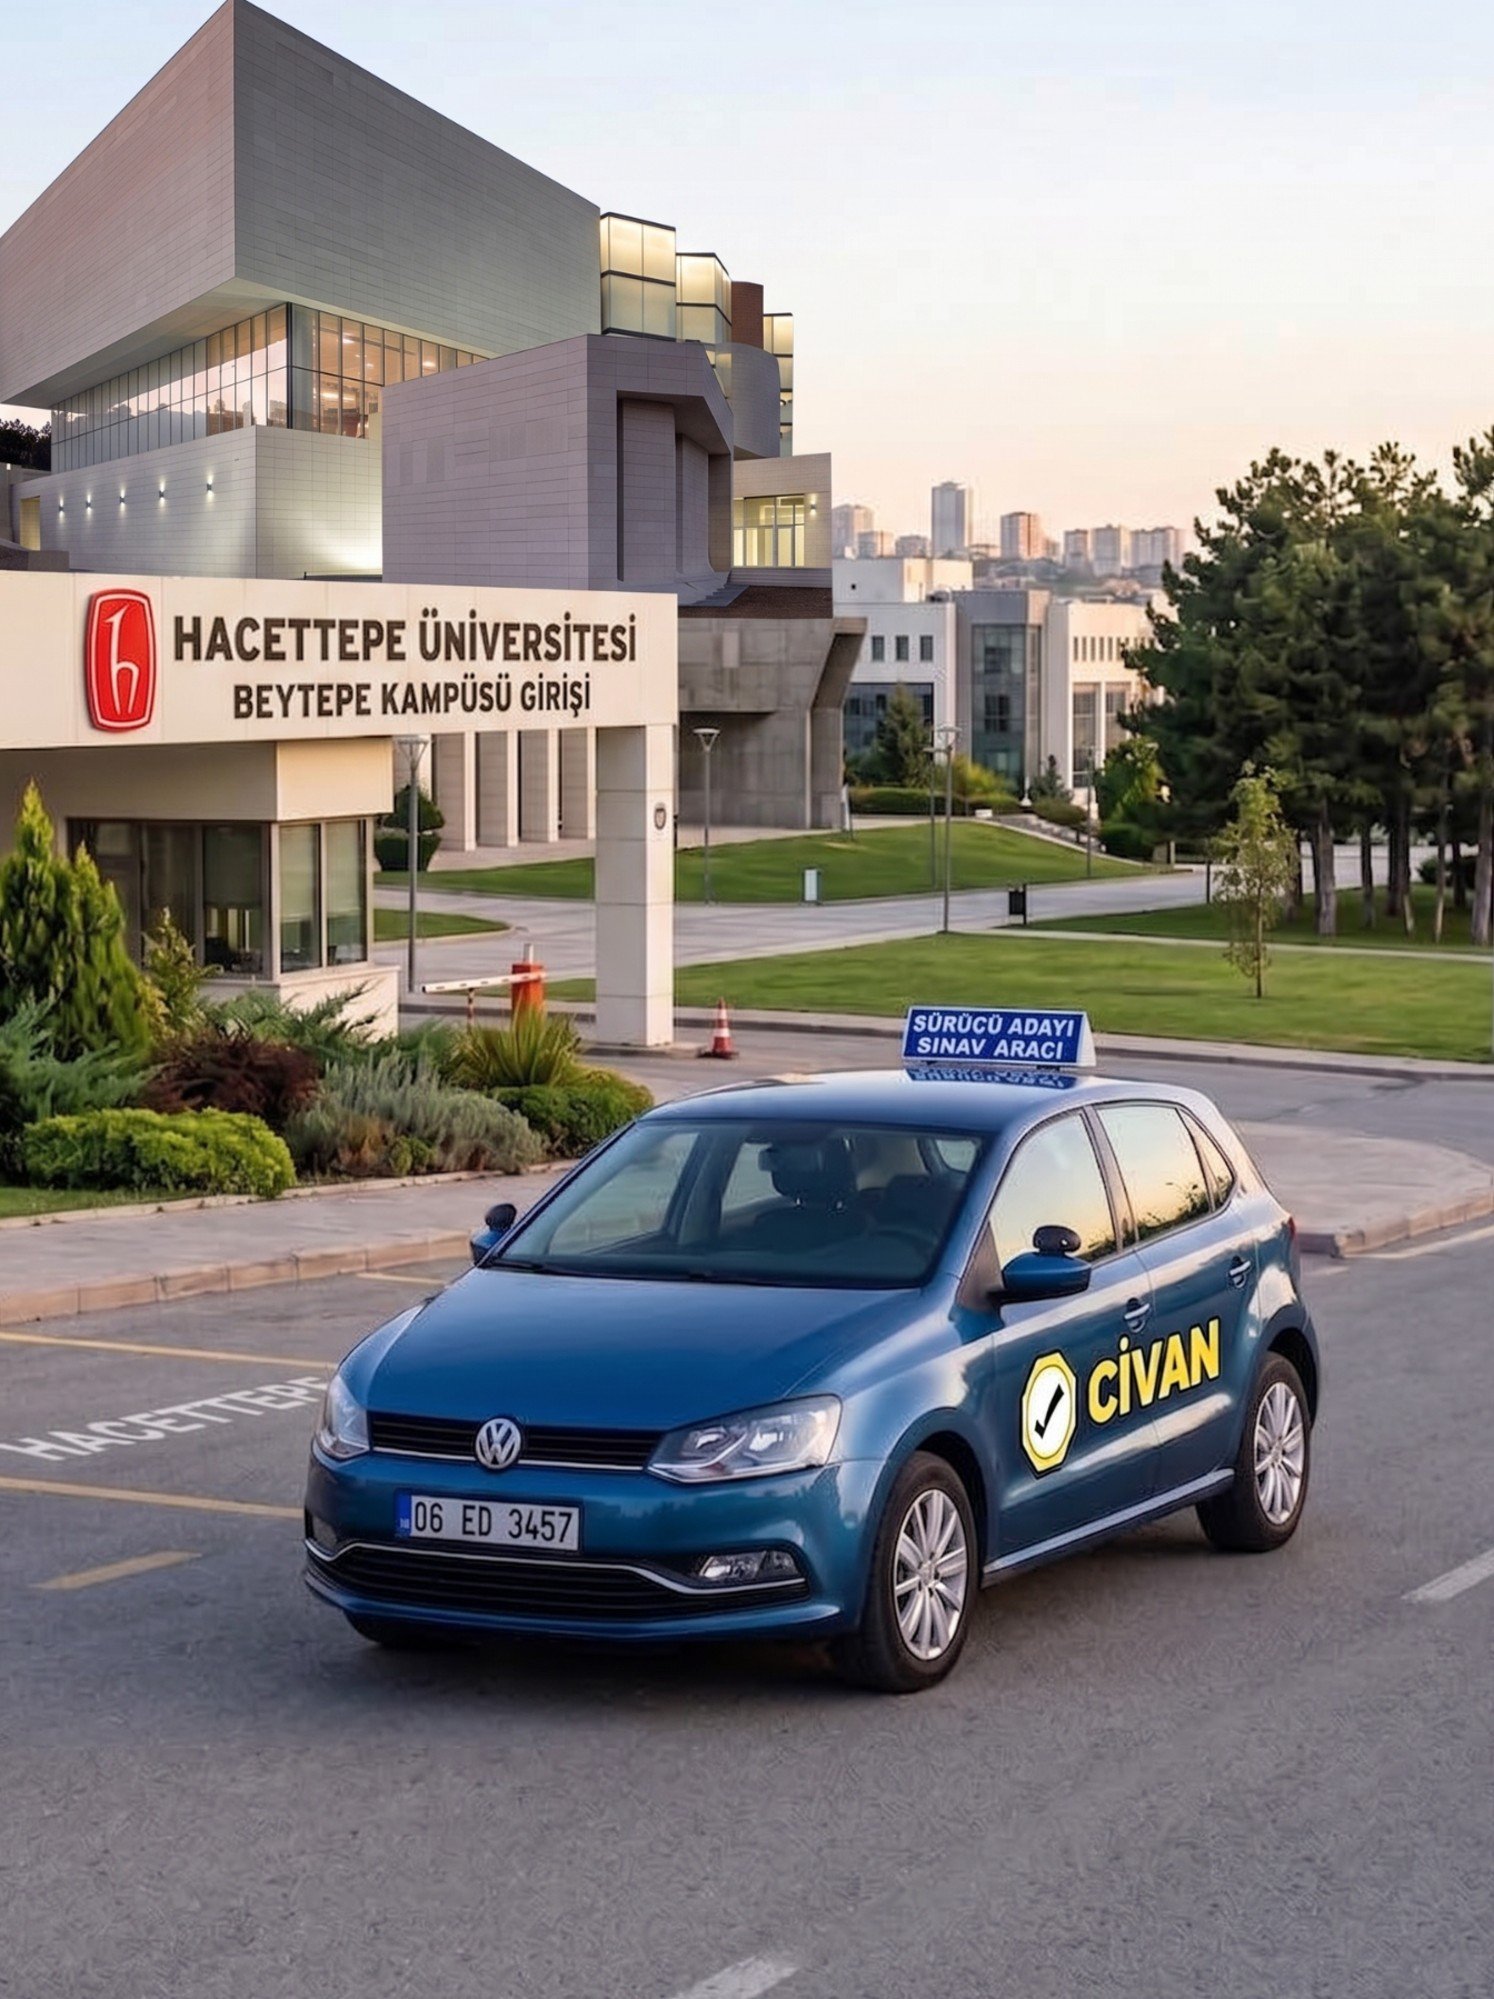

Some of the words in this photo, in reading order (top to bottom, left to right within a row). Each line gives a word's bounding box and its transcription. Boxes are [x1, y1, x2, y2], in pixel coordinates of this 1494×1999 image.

[174, 616, 407, 662] HACETTEPE
[419, 607, 637, 662] ÜNİVERSİTESİ
[233, 683, 371, 719] BEYTEPE
[381, 672, 512, 714] KAMPÜSÜ
[520, 672, 591, 718] GİRİŞİ
[913, 1012, 1003, 1035] SÜRÜCÜ
[1007, 1018, 1075, 1037] ADAYI
[916, 1036, 987, 1055] SINAV
[993, 1039, 1064, 1060] ARACI
[1088, 1318, 1220, 1424] CİVAN
[414, 1501, 443, 1533] 06
[461, 1504, 492, 1537] ED
[507, 1508, 573, 1543] 3457
